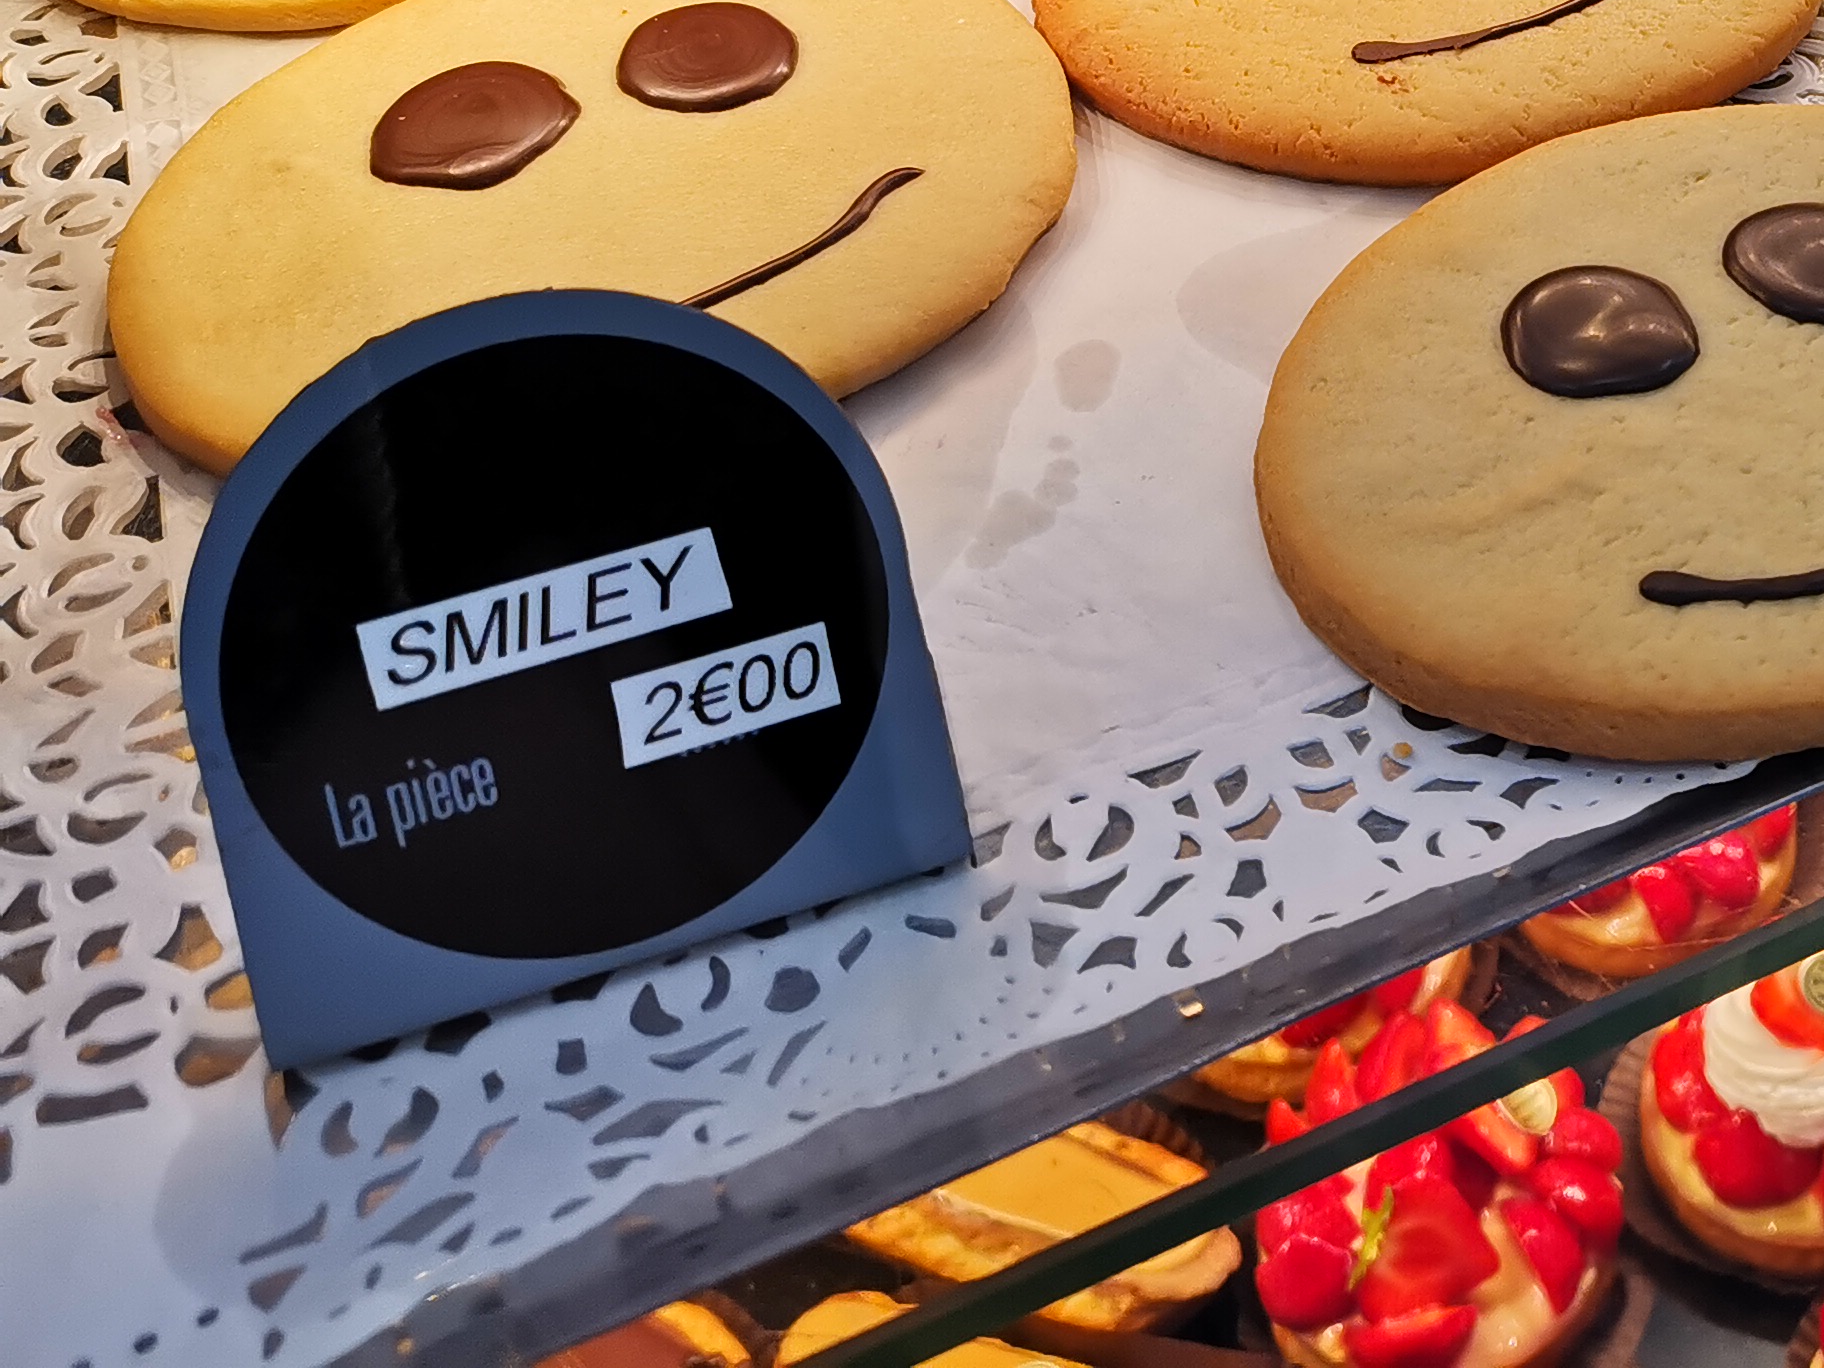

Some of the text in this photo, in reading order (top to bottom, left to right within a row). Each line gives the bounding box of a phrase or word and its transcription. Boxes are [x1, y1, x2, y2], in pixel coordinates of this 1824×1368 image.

[385, 543, 696, 687] SMILEY
[642, 640, 823, 746] 2€00
[325, 755, 499, 849] La pièce
